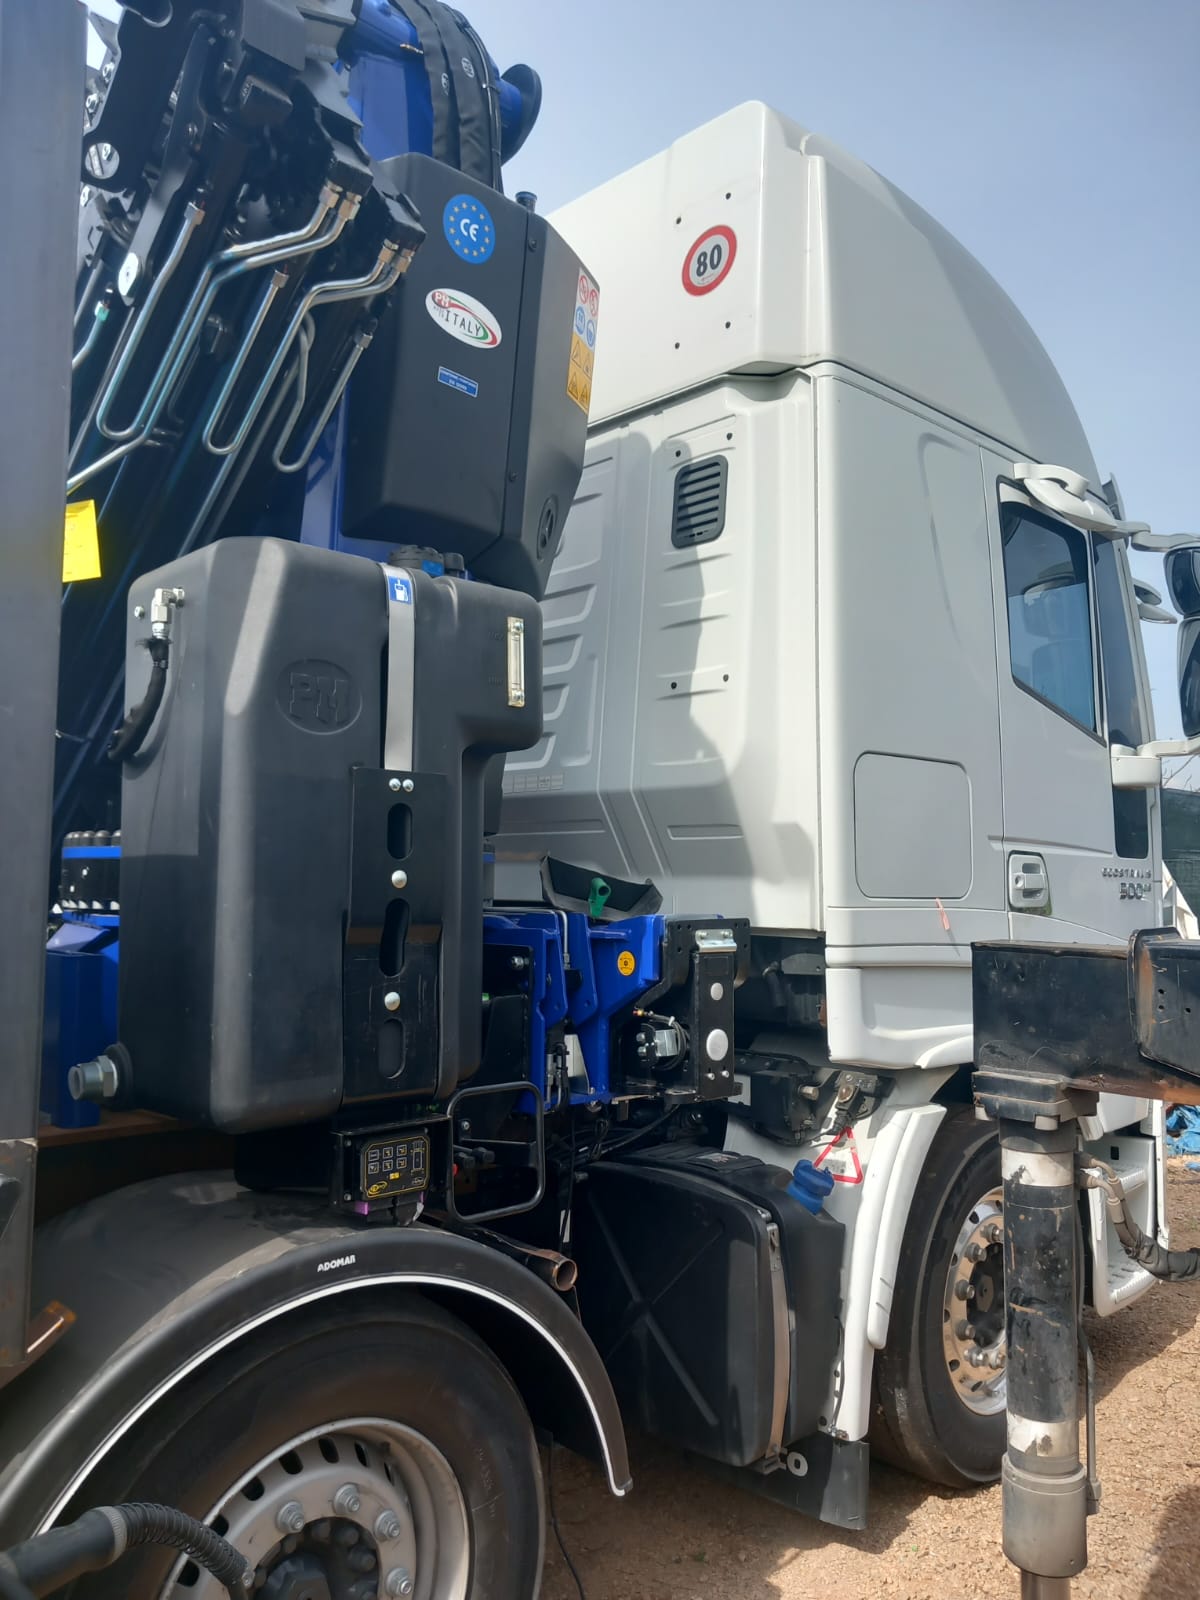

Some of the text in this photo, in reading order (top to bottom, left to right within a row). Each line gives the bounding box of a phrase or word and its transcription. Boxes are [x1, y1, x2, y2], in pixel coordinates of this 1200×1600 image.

[460, 218, 479, 242] CE
[696, 244, 722, 277] 80
[445, 309, 481, 337] ITALY
[317, 1254, 356, 1272] ADOMAR
